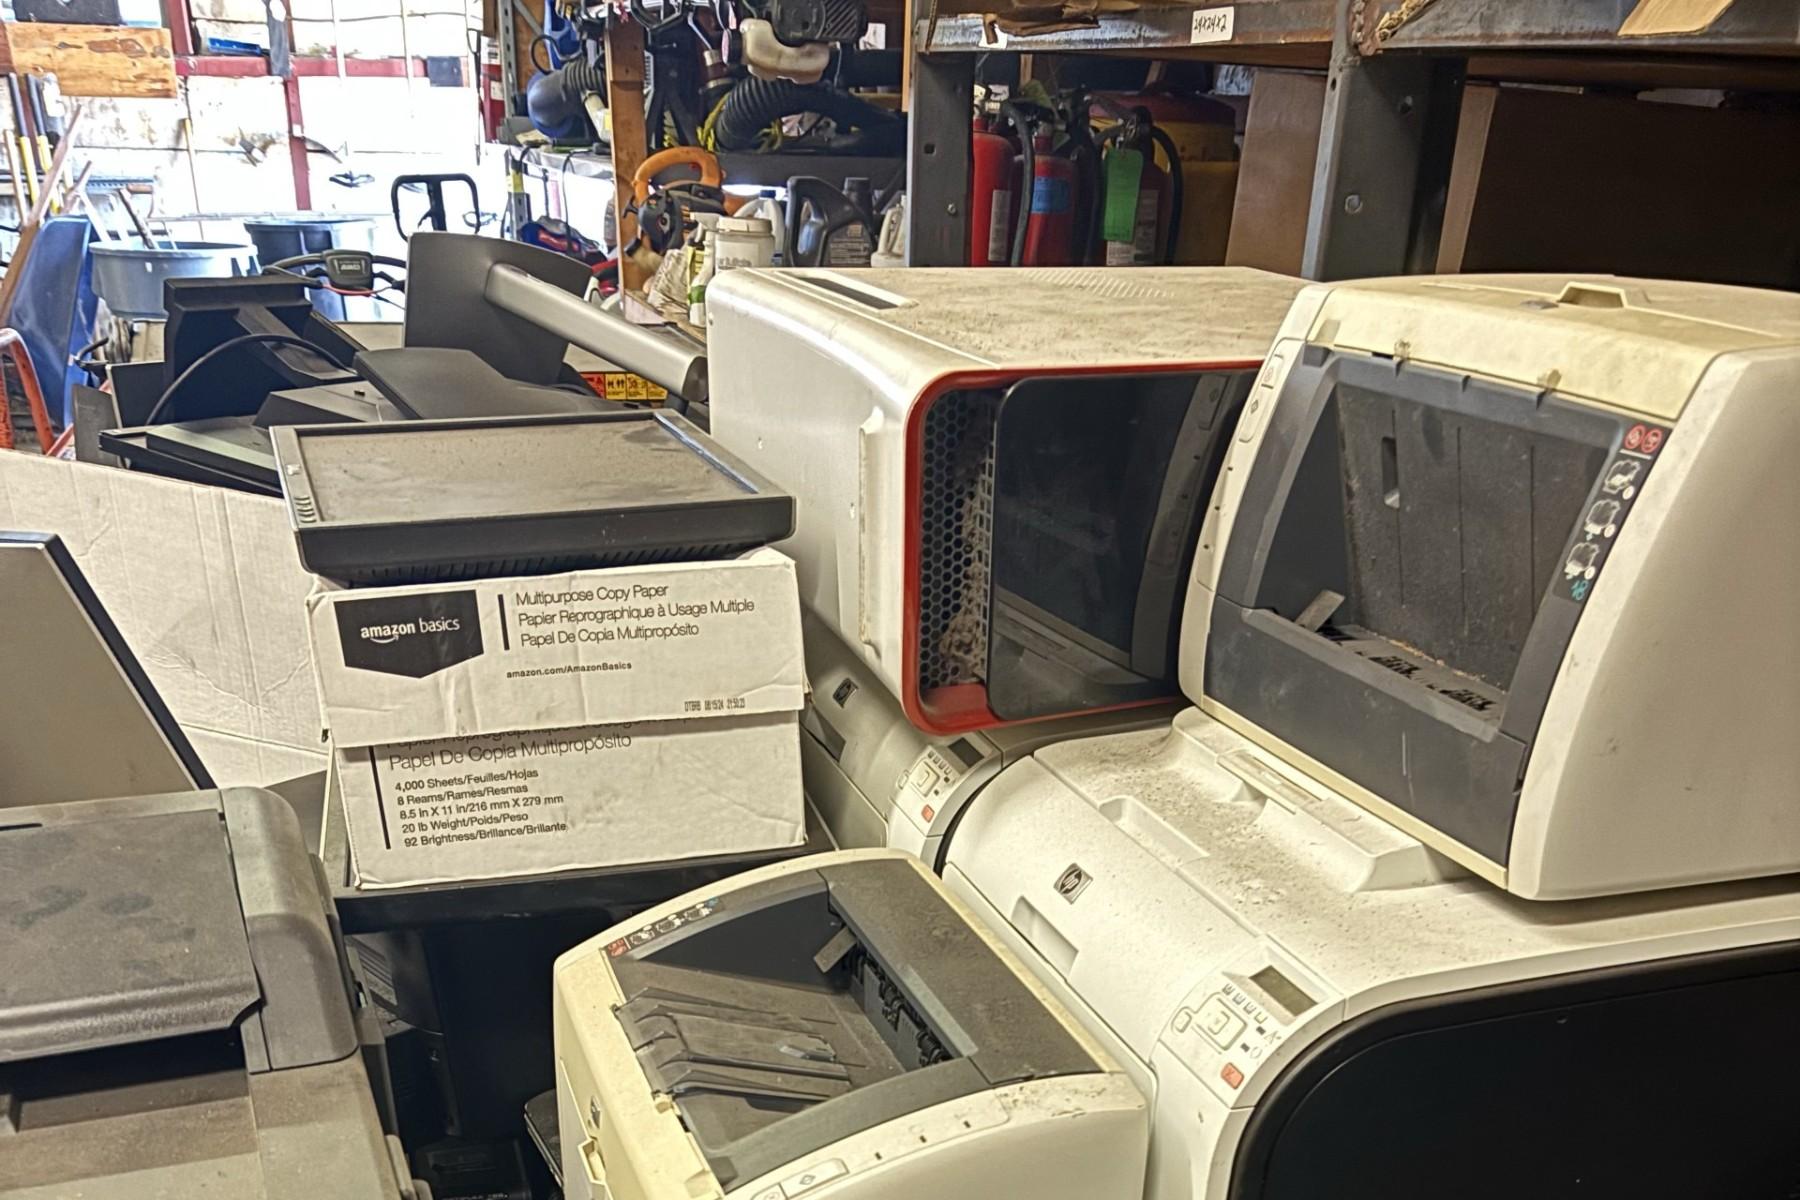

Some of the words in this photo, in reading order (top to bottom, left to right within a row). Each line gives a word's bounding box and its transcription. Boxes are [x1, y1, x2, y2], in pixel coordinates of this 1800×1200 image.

[516, 589, 594, 606] Multipurpose
[596, 586, 631, 602] Copy
[633, 584, 669, 599] Paper
[519, 611, 558, 627] Papier
[559, 606, 655, 625] Reprographique
[657, 604, 665, 617] à
[668, 602, 708, 618] Usage
[710, 599, 755, 614] Multiple
[360, 621, 416, 641] amazon
[419, 617, 461, 633] basics
[521, 633, 555, 648] Papel
[558, 630, 576, 644] De
[578, 628, 615, 644] Copia
[617, 622, 700, 640] Multipropósito
[506, 661, 632, 679] amazon.com/AmazonBasics
[389, 751, 436, 772] Papel
[441, 749, 464, 765] De
[468, 743, 517, 763] Copia
[522, 734, 632, 758] Multipropósito
[395, 780, 425, 792] 4,000
[427, 769, 539, 789] Sheets/Feuilles/Hojas
[397, 796, 405, 806] 8
[406, 784, 529, 805] Reams/Rames/Resmas
[400, 810, 417, 820] 8.5
[431, 807, 440, 817] X
[441, 806, 452, 816] 11
[490, 800, 510, 810] mm
[512, 799, 521, 808] X
[522, 796, 541, 807] 279
[544, 794, 564, 804] mm
[402, 824, 416, 834] 20
[418, 822, 428, 832] lb
[430, 813, 529, 832] Weight/Poids/Peso
[405, 837, 418, 848] 92
[421, 823, 567, 847] Brightness/Brillance/Brillante
